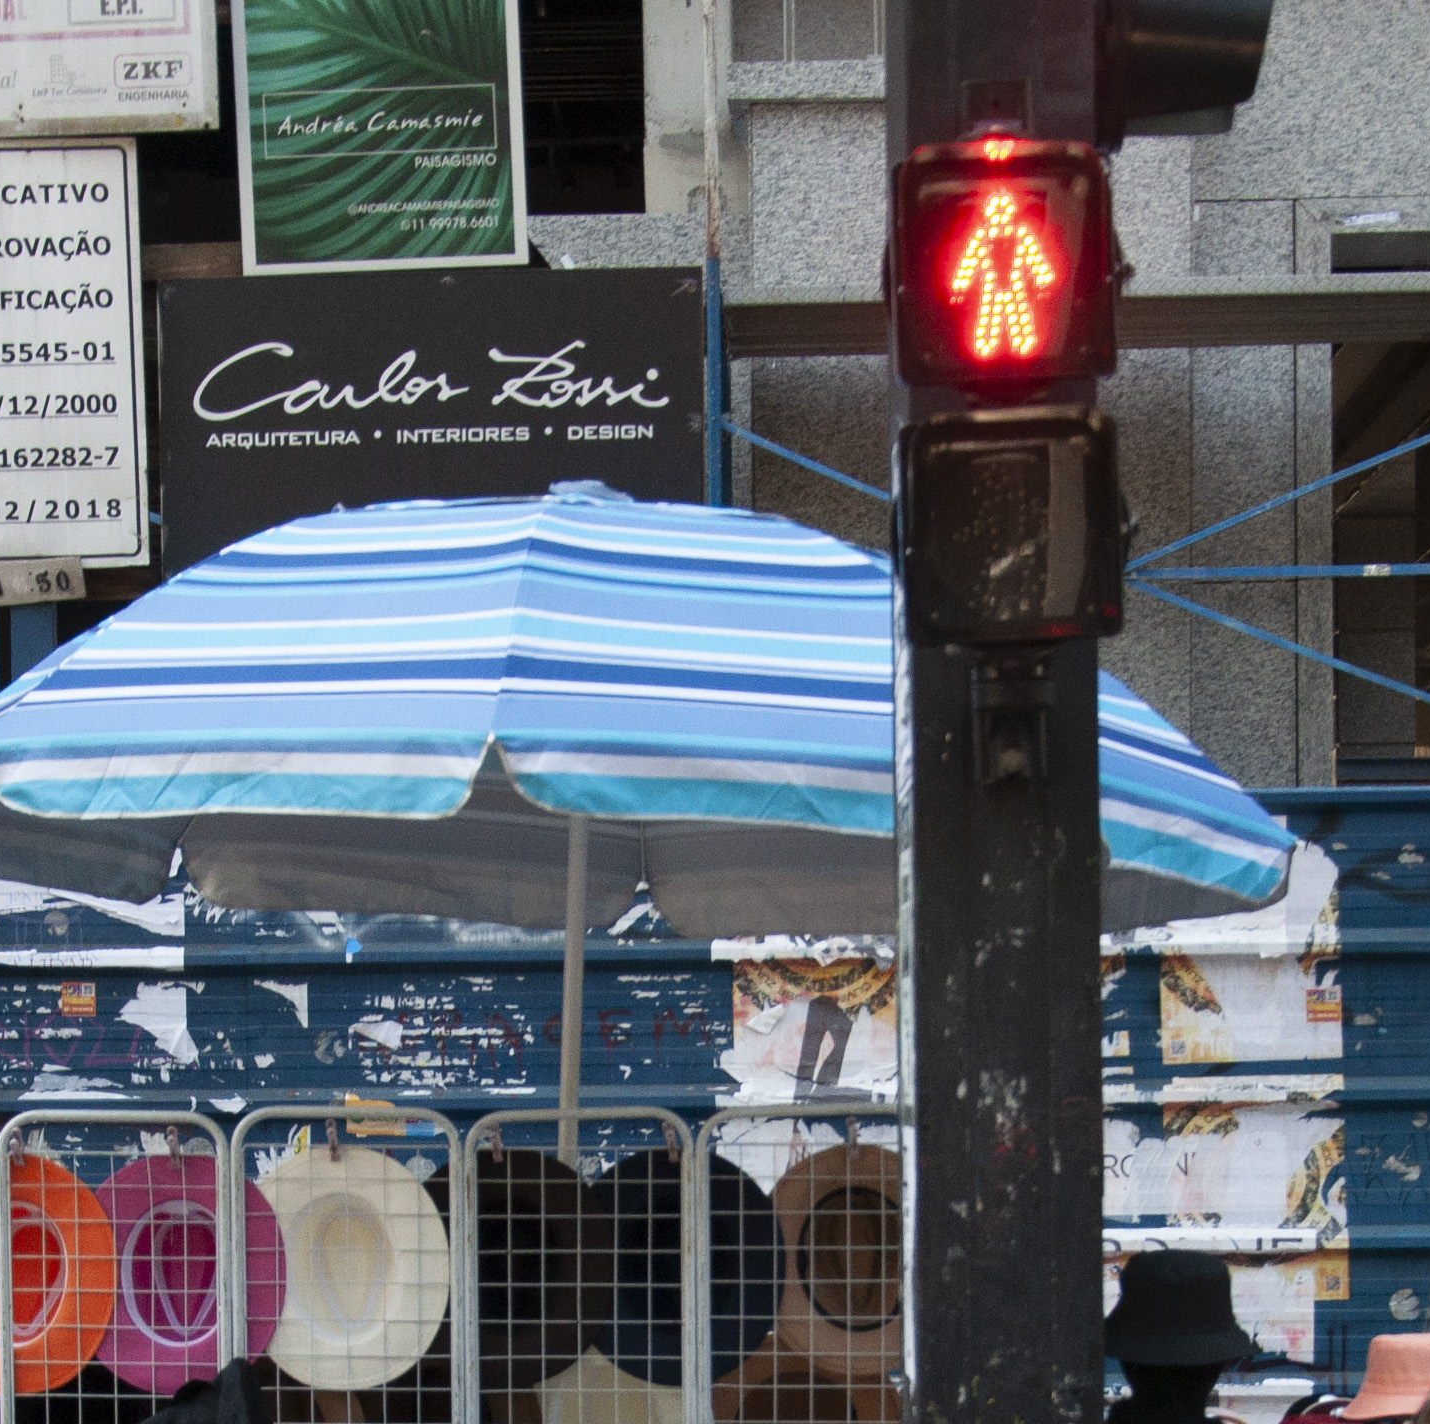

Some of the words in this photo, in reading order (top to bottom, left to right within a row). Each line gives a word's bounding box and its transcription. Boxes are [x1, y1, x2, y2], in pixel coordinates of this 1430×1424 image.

[123, 60, 184, 82] ZKF
[118, 89, 190, 103] ENGENHARIA
[277, 112, 358, 138] Andréa
[367, 108, 484, 133] Camasmie
[414, 153, 498, 170] PAISAGISMO
[429, 214, 499, 230] 99978.6601
[192, 341, 470, 422] Carlos
[205, 430, 361, 450] ARQUITETURA
[396, 426, 531, 444] INTERIORES
[567, 424, 654, 441] DESIGN
